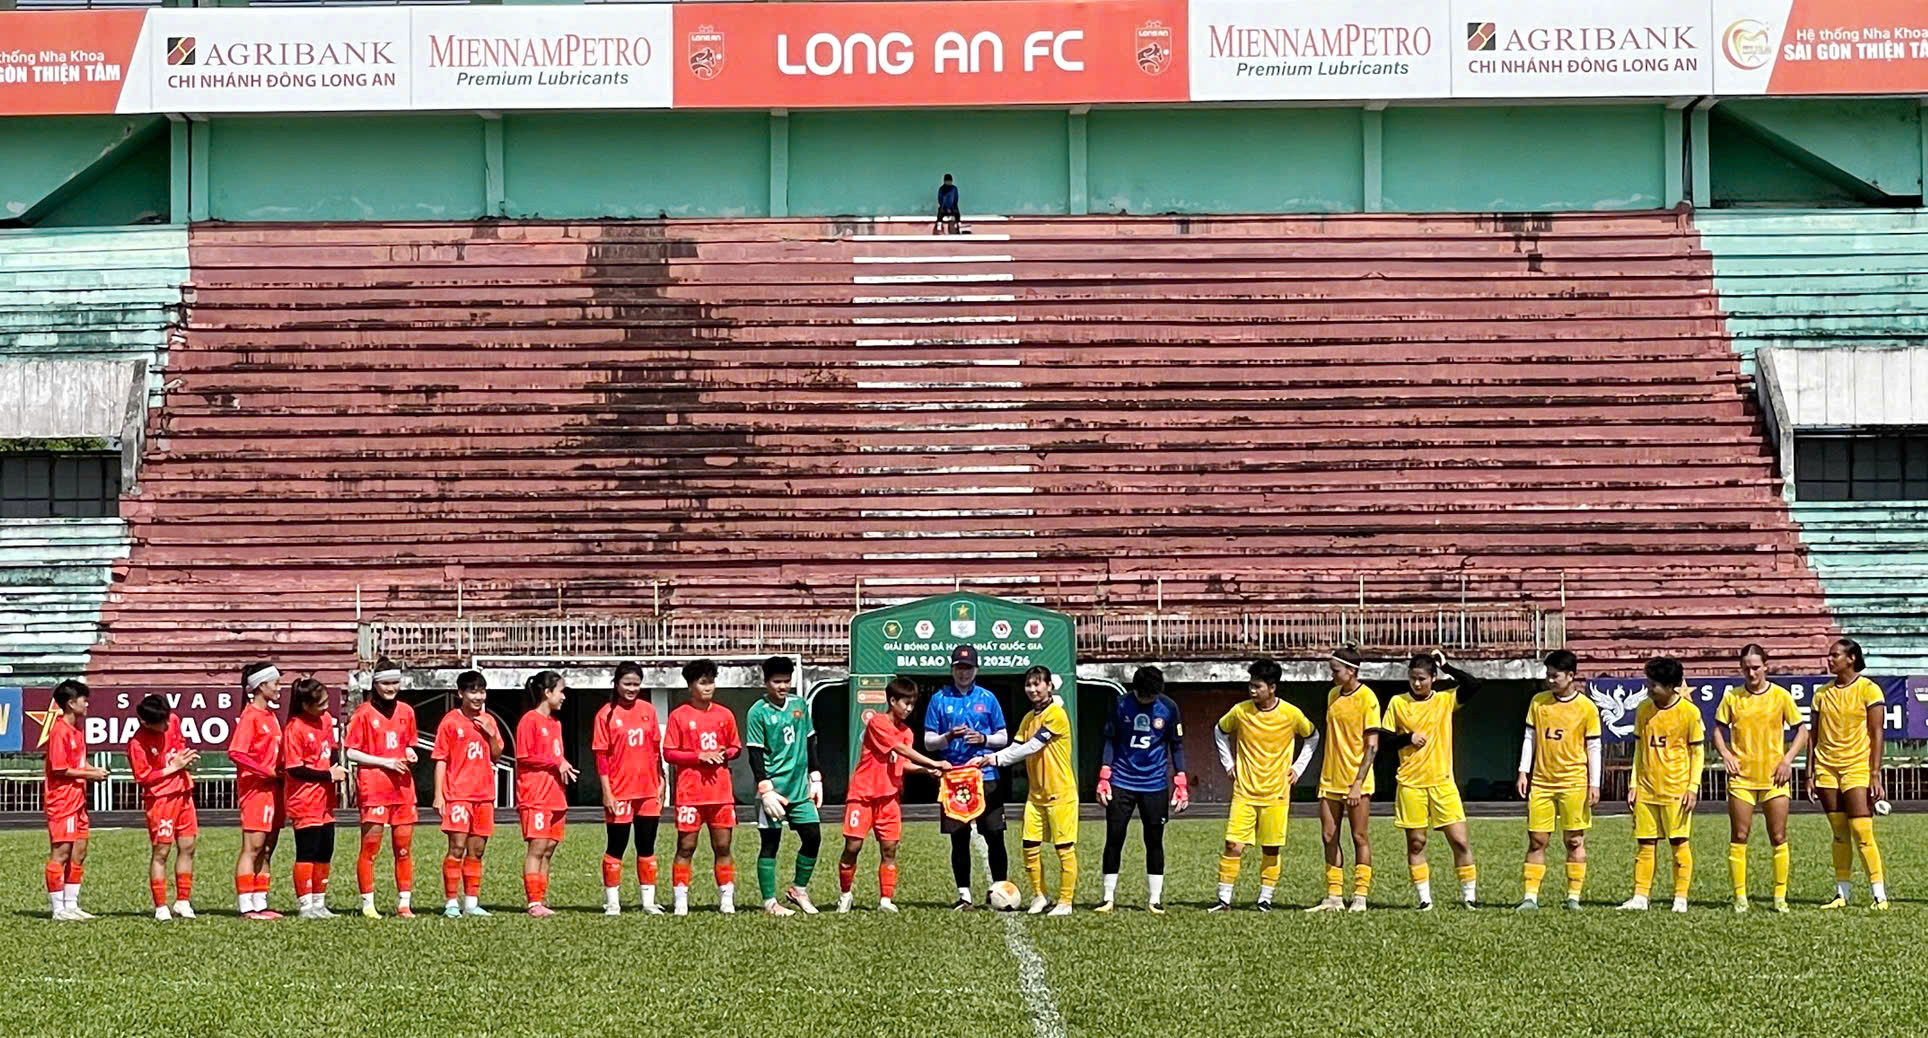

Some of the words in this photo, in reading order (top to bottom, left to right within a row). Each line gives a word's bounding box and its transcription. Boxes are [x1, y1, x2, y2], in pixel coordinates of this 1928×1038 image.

[1503, 25, 1697, 51] AGRIBANK
[1796, 28, 1815, 44] Hệ
[1819, 26, 1859, 43] thống
[1863, 28, 1890, 40] Nha
[1894, 27, 1928, 40] Khoa
[0, 49, 36, 65] hống
[40, 51, 66, 62] Nha
[70, 50, 104, 62] Khoa
[203, 42, 396, 66] AGRIBANK
[777, 32, 914, 76] LONG
[934, 31, 1004, 74] AN
[1023, 30, 1084, 72] FC
[1783, 41, 1812, 61] SÀI
[1817, 40, 1851, 60] GÒN
[1856, 40, 1904, 62] THIỆN
[32, 63, 80, 85] THIỆN
[85, 61, 120, 81] TÂM
[1236, 61, 1312, 76] Premium
[1317, 60, 1409, 75] Lubricants
[1468, 60, 1496, 73] CHI
[1501, 57, 1563, 73] NHÁNH
[1567, 56, 1617, 73] ĐÔNG
[1623, 58, 1669, 72] LONG
[1673, 58, 1697, 71] AN
[168, 74, 195, 88] CHI
[200, 72, 262, 88] NHÁNH
[266, 72, 316, 88] ĐÔNG
[321, 73, 367, 87] LONG
[372, 73, 395, 86] AN
[456, 71, 532, 86] Premium
[537, 70, 629, 86] Lubricants
[883, 641, 902, 651] GIẢI
[904, 641, 929, 651] BÓNG
[931, 641, 944, 651] ĐÁ
[999, 640, 1026, 651] QUỐC
[897, 656, 918, 667] BIA
[920, 656, 945, 667] SAO
[983, 655, 1030, 667] 2025/26
[85, 717, 140, 744] BIA
[180, 717, 229, 744] AO
[627, 728, 644, 747] 27
[783, 724, 795, 745] 21
[1545, 727, 1564, 741] LS
[385, 731, 398, 749] 18
[700, 732, 717, 750] 26
[1129, 735, 1151, 749] LS
[1649, 735, 1667, 748] LS
[467, 741, 483, 760] 24
[451, 805, 469, 824] 24
[534, 812, 545, 831] 8
[678, 805, 697, 824] 26
[850, 809, 861, 828] 6
